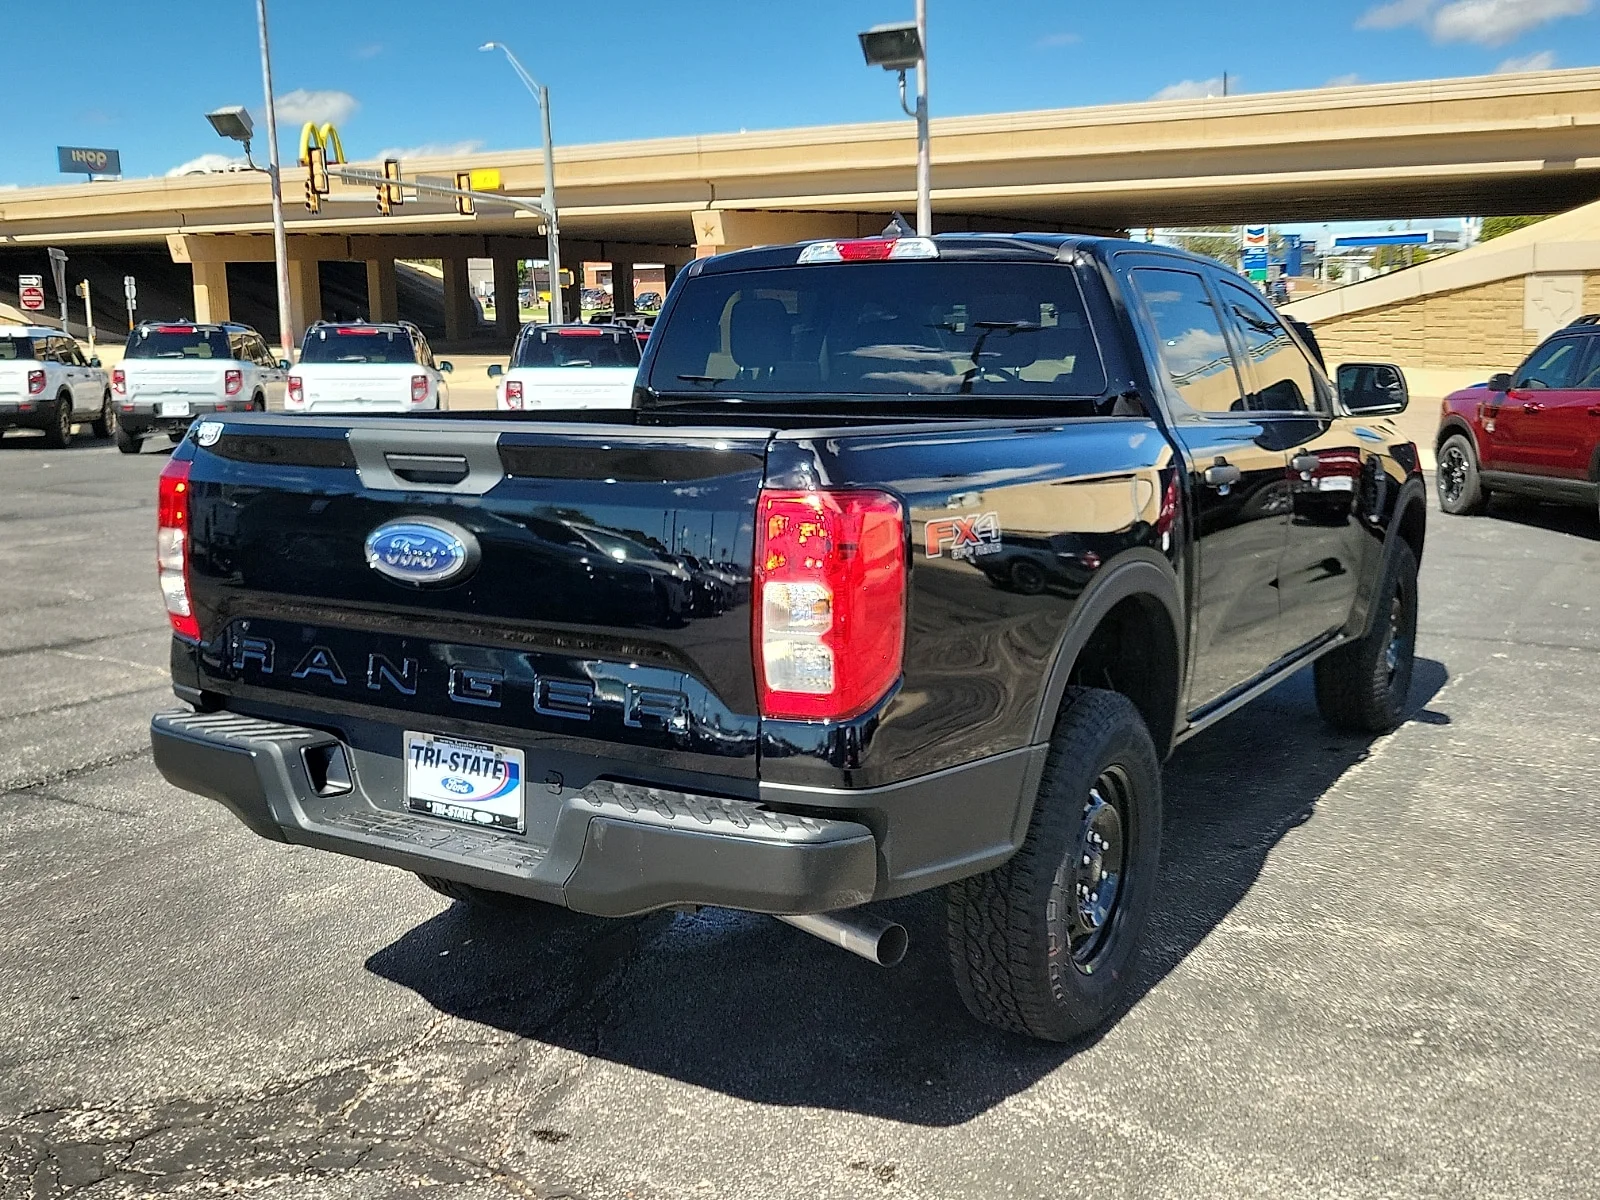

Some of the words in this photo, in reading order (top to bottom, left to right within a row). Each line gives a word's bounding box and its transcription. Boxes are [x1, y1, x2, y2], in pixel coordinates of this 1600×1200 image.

[386, 535, 438, 568] Ford
[925, 512, 1000, 558] FX4
[233, 638, 690, 734] RANGER
[411, 745, 503, 780] TRI-STATE
[445, 777, 469, 793] Ford
[431, 801, 474, 821] TRI-STATE
